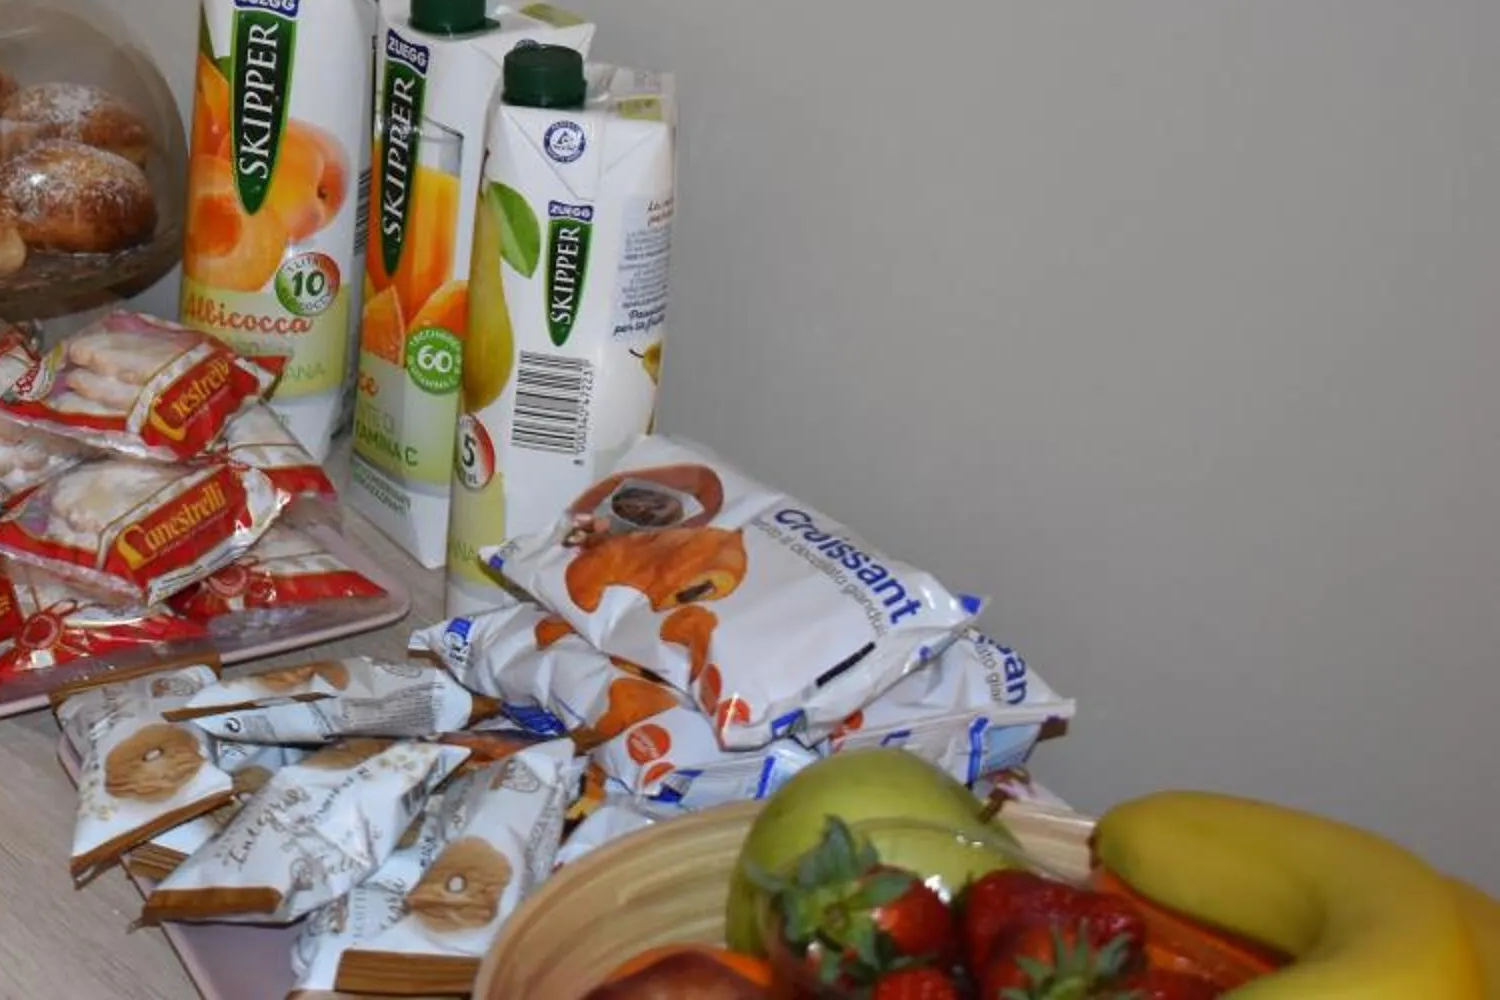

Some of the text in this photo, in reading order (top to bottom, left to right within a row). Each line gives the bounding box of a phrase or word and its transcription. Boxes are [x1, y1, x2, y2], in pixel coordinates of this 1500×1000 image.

[388, 34, 427, 67] ZUEGG
[239, 21, 280, 179] SKIPPER
[384, 76, 415, 242] SKIPPER
[551, 205, 592, 219] ZUEGG
[291, 270, 326, 298] 10
[551, 226, 581, 325] SKIPPER
[183, 293, 314, 335] Albicocca
[417, 345, 453, 374] 60
[461, 433, 477, 468] 5
[116, 481, 227, 571] Canestrelli
